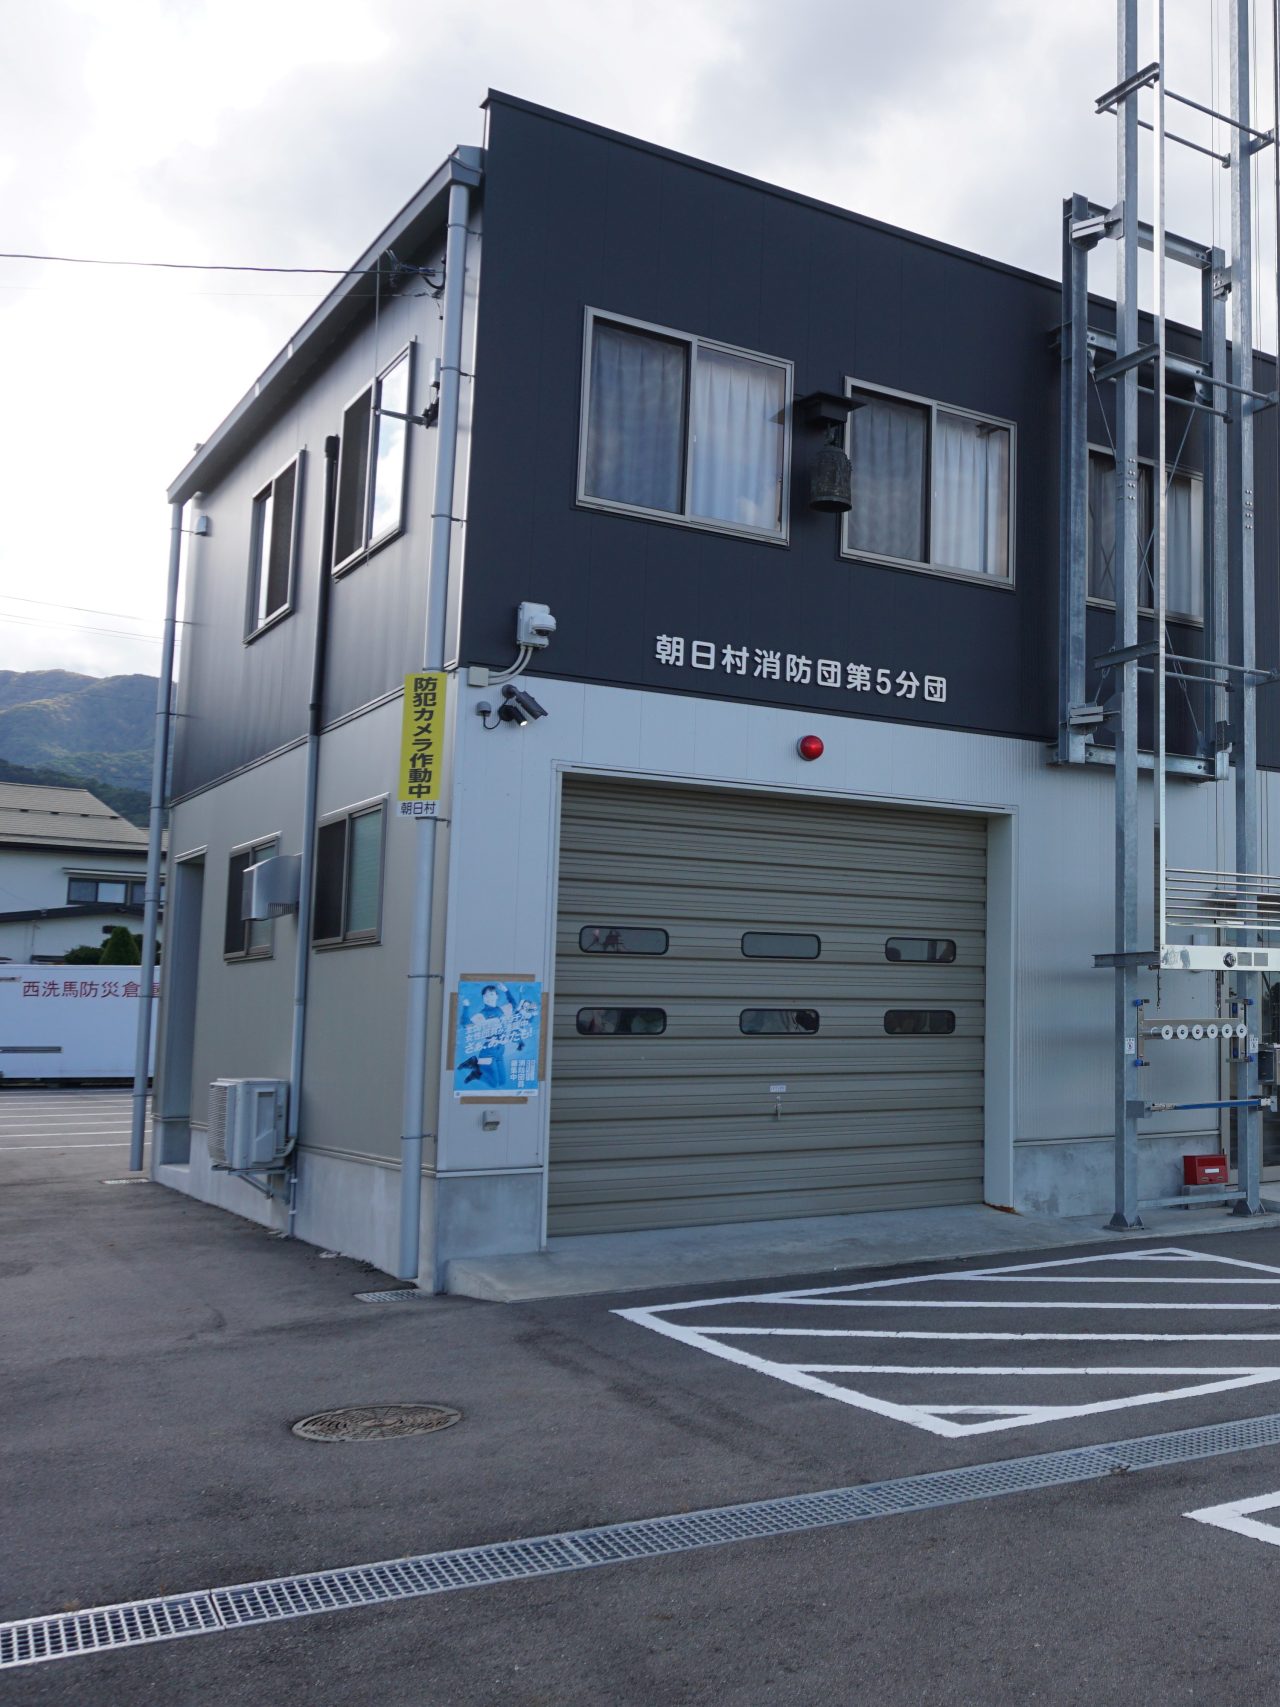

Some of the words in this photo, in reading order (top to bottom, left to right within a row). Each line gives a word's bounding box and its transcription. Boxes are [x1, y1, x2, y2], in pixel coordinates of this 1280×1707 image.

[654, 633, 947, 702] 朝日村消防団第5分団
[408, 676, 438, 799] 防犯カメラ作動中
[400, 801, 436, 815] 朝日村
